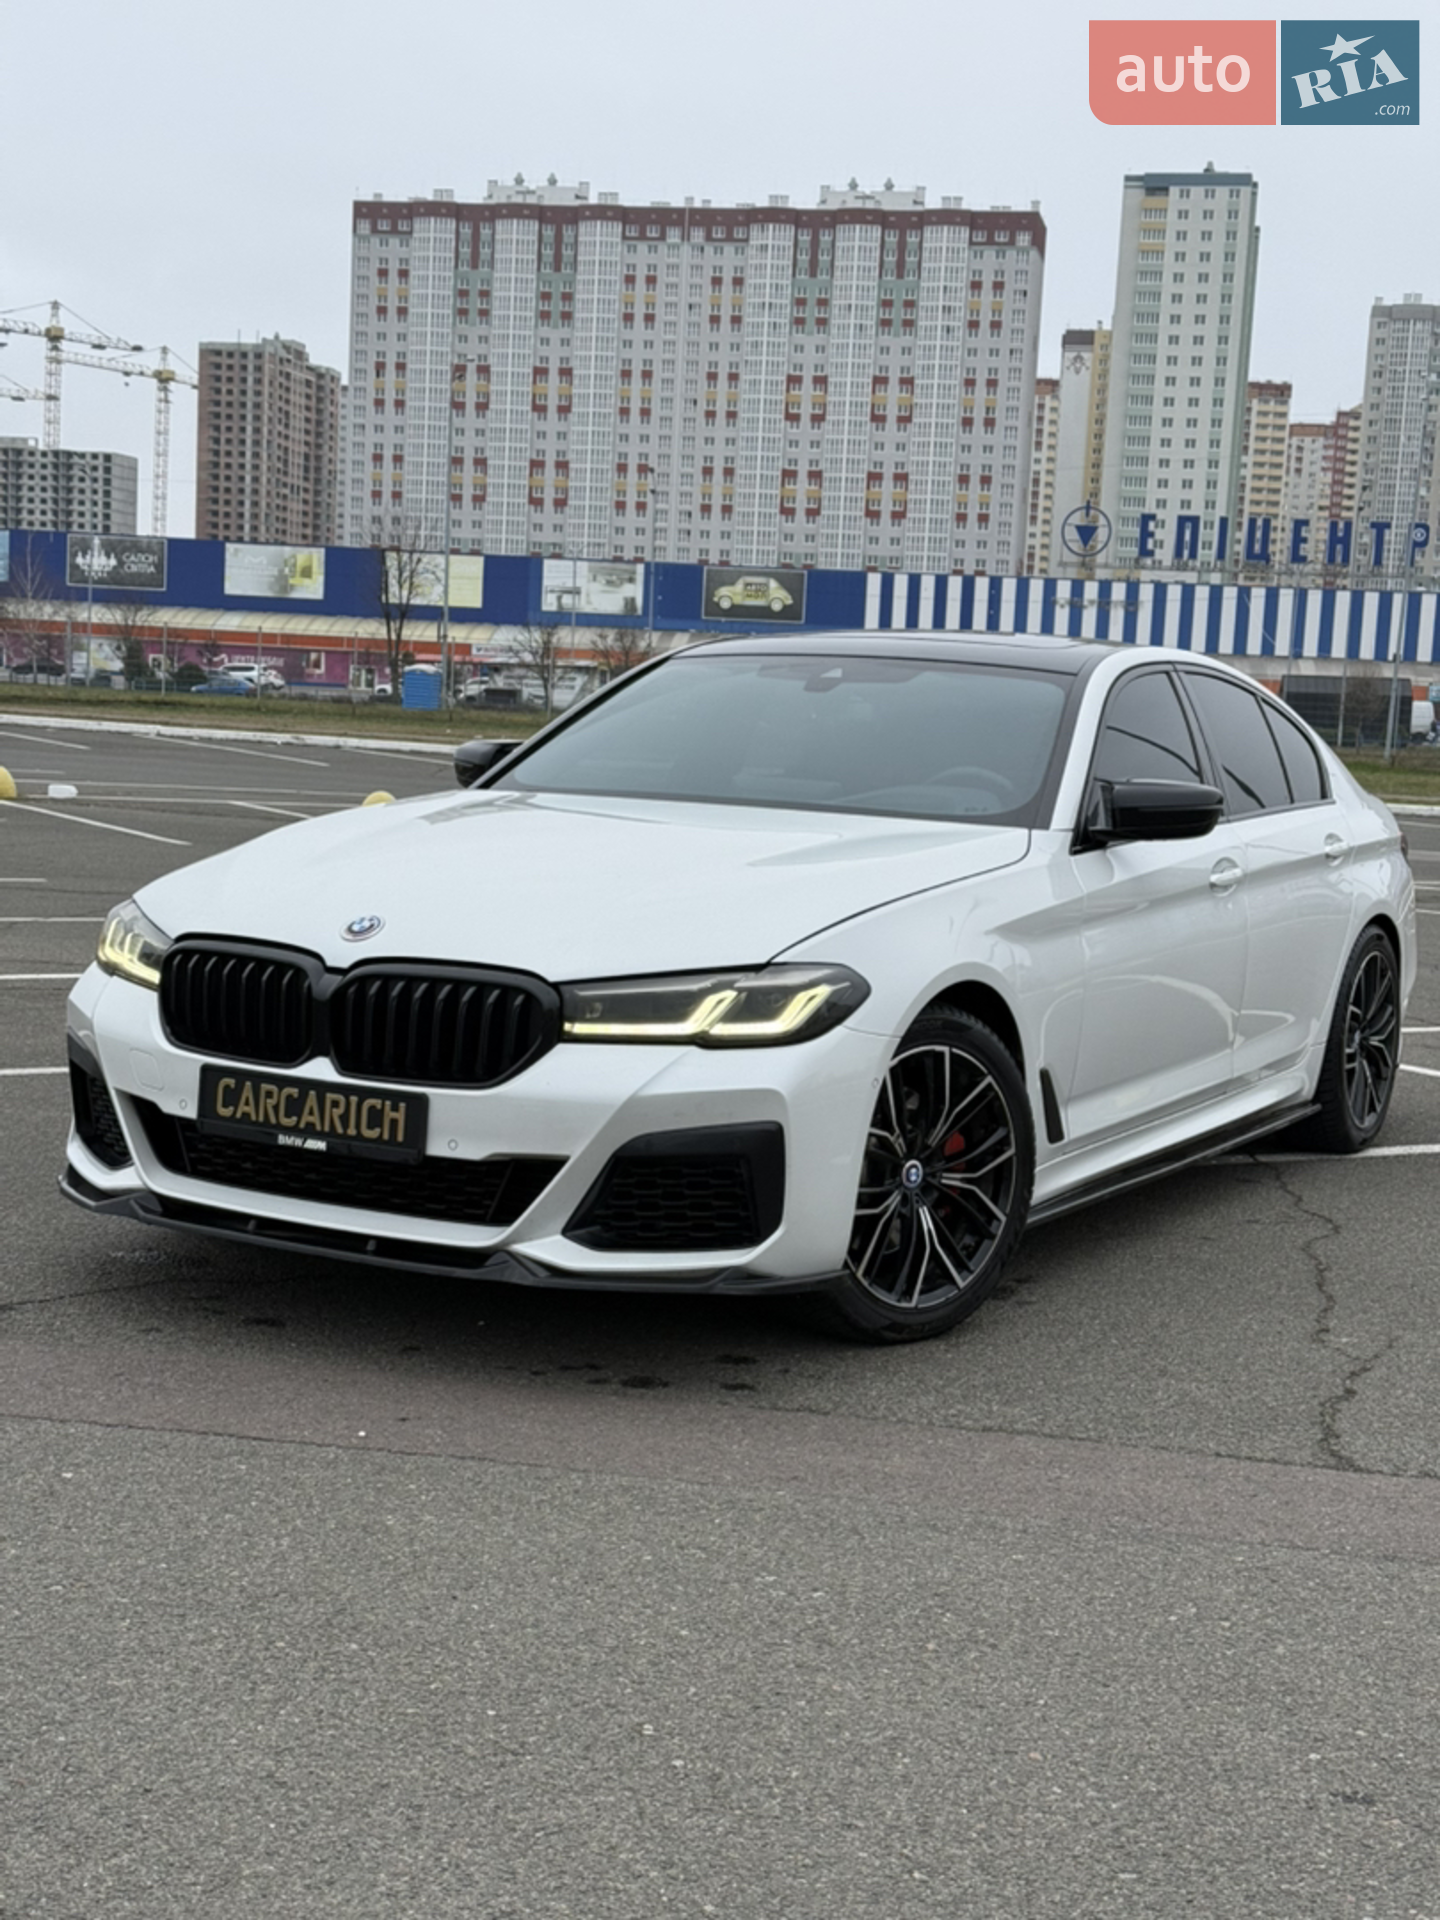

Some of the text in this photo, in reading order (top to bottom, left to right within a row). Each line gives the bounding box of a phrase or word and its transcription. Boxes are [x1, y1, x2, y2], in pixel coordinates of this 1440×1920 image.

[1138, 513, 1430, 567] ЕПІЦЕНТР
[215, 1076, 407, 1143] CARCARICH
[278, 1133, 303, 1147] BMW
